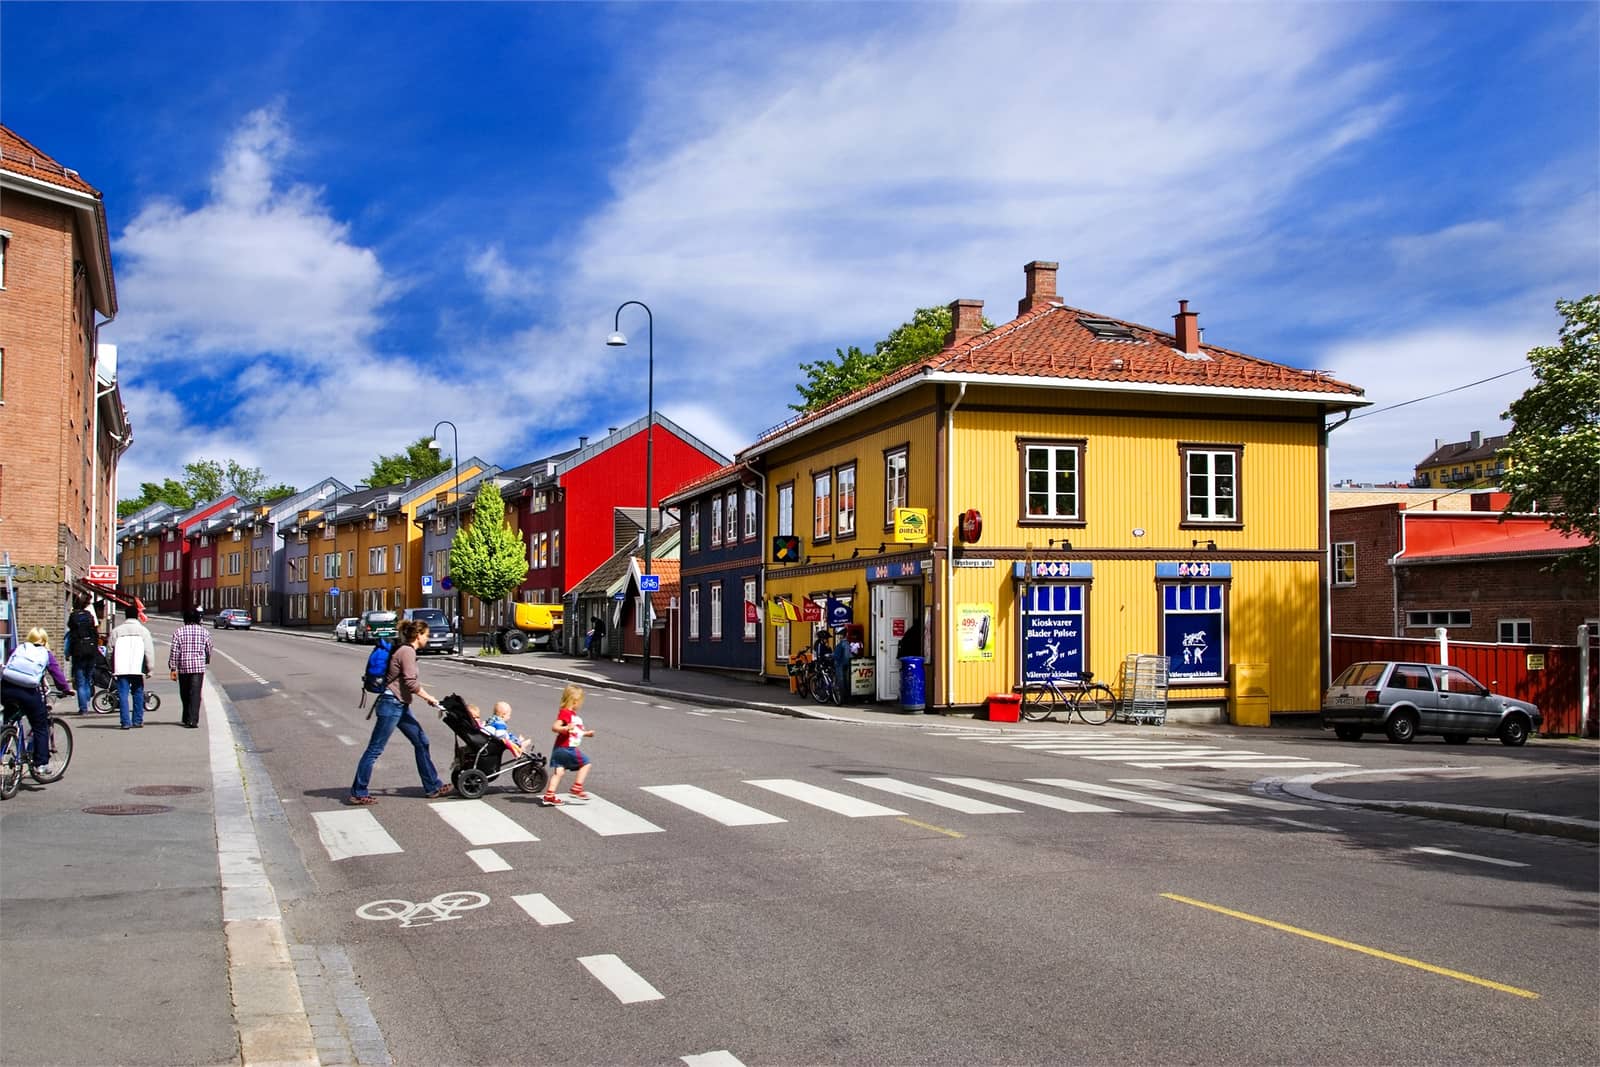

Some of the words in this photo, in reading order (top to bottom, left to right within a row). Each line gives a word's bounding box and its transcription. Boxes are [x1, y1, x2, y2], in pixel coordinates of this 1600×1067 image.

[1031, 618, 1073, 627] Kioskvarer
[1027, 629, 1051, 637] Blader
[1053, 629, 1077, 637] Pølser
